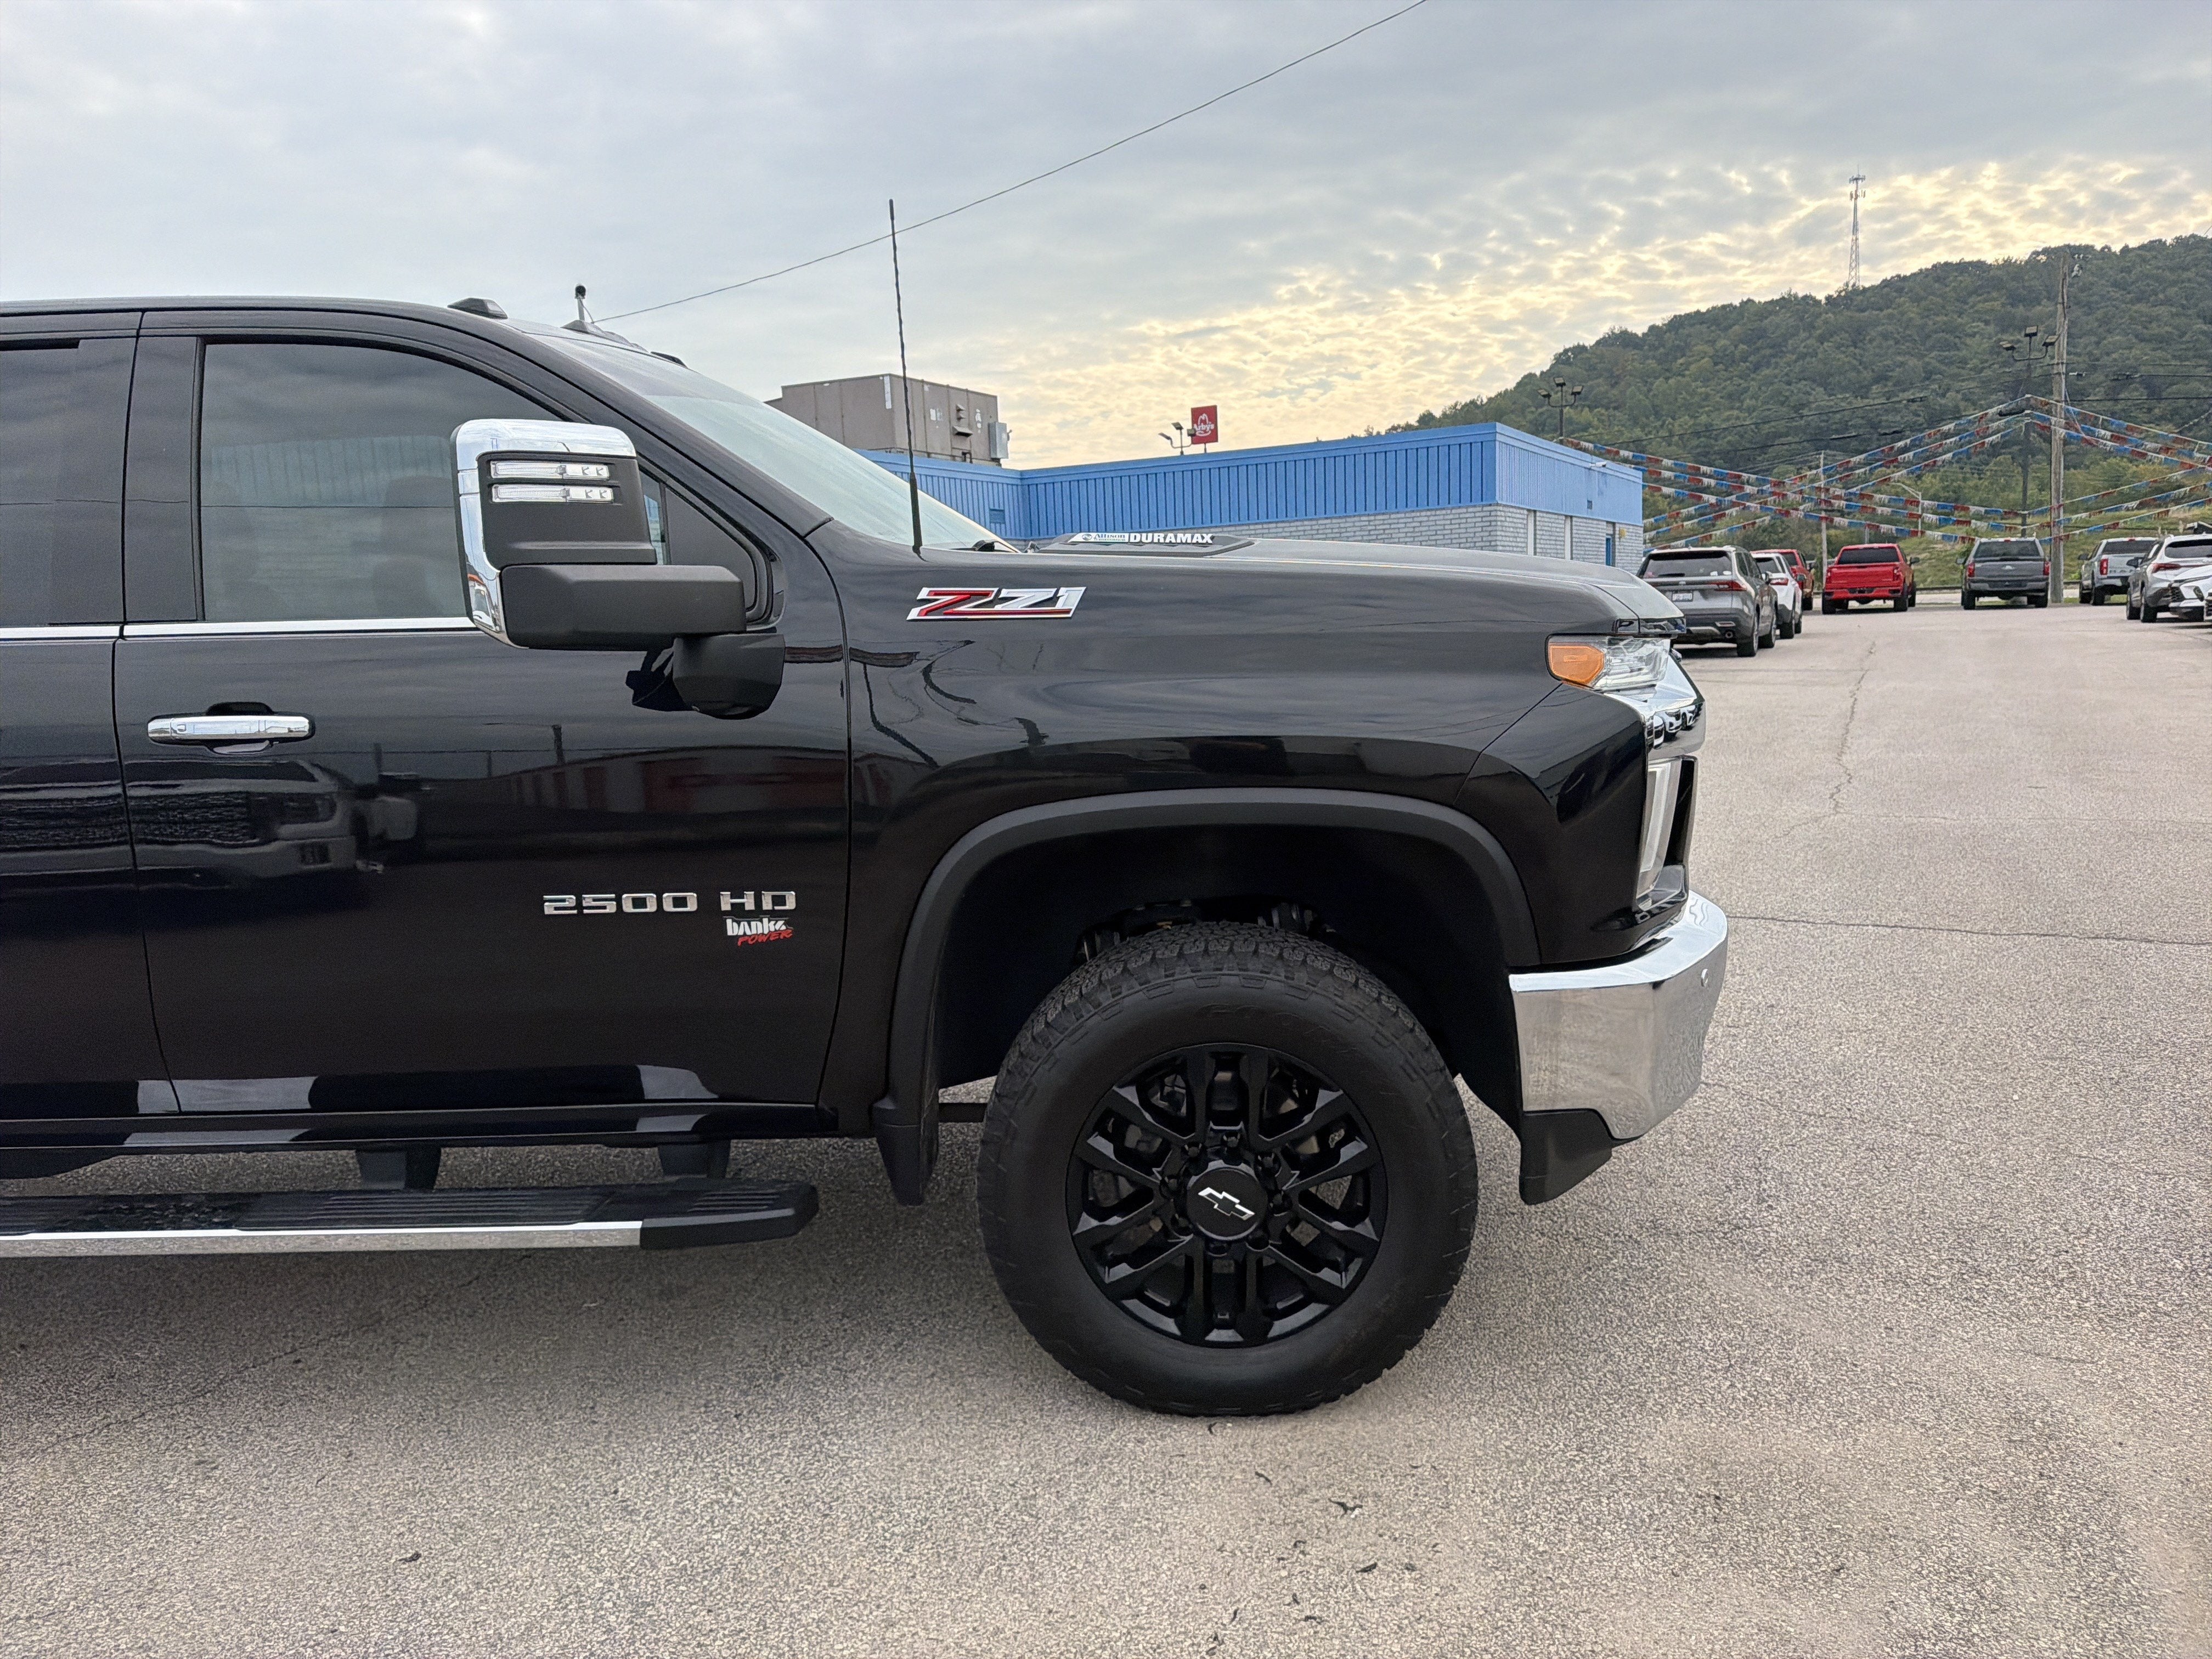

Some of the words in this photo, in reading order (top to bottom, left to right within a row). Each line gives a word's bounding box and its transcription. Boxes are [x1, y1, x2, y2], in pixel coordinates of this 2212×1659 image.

[1130, 533, 1214, 544] DURAMAX
[906, 587, 1087, 620] Z71
[543, 893, 698, 915] 2500
[720, 891, 796, 911] HD
[737, 929, 793, 946] POWER
